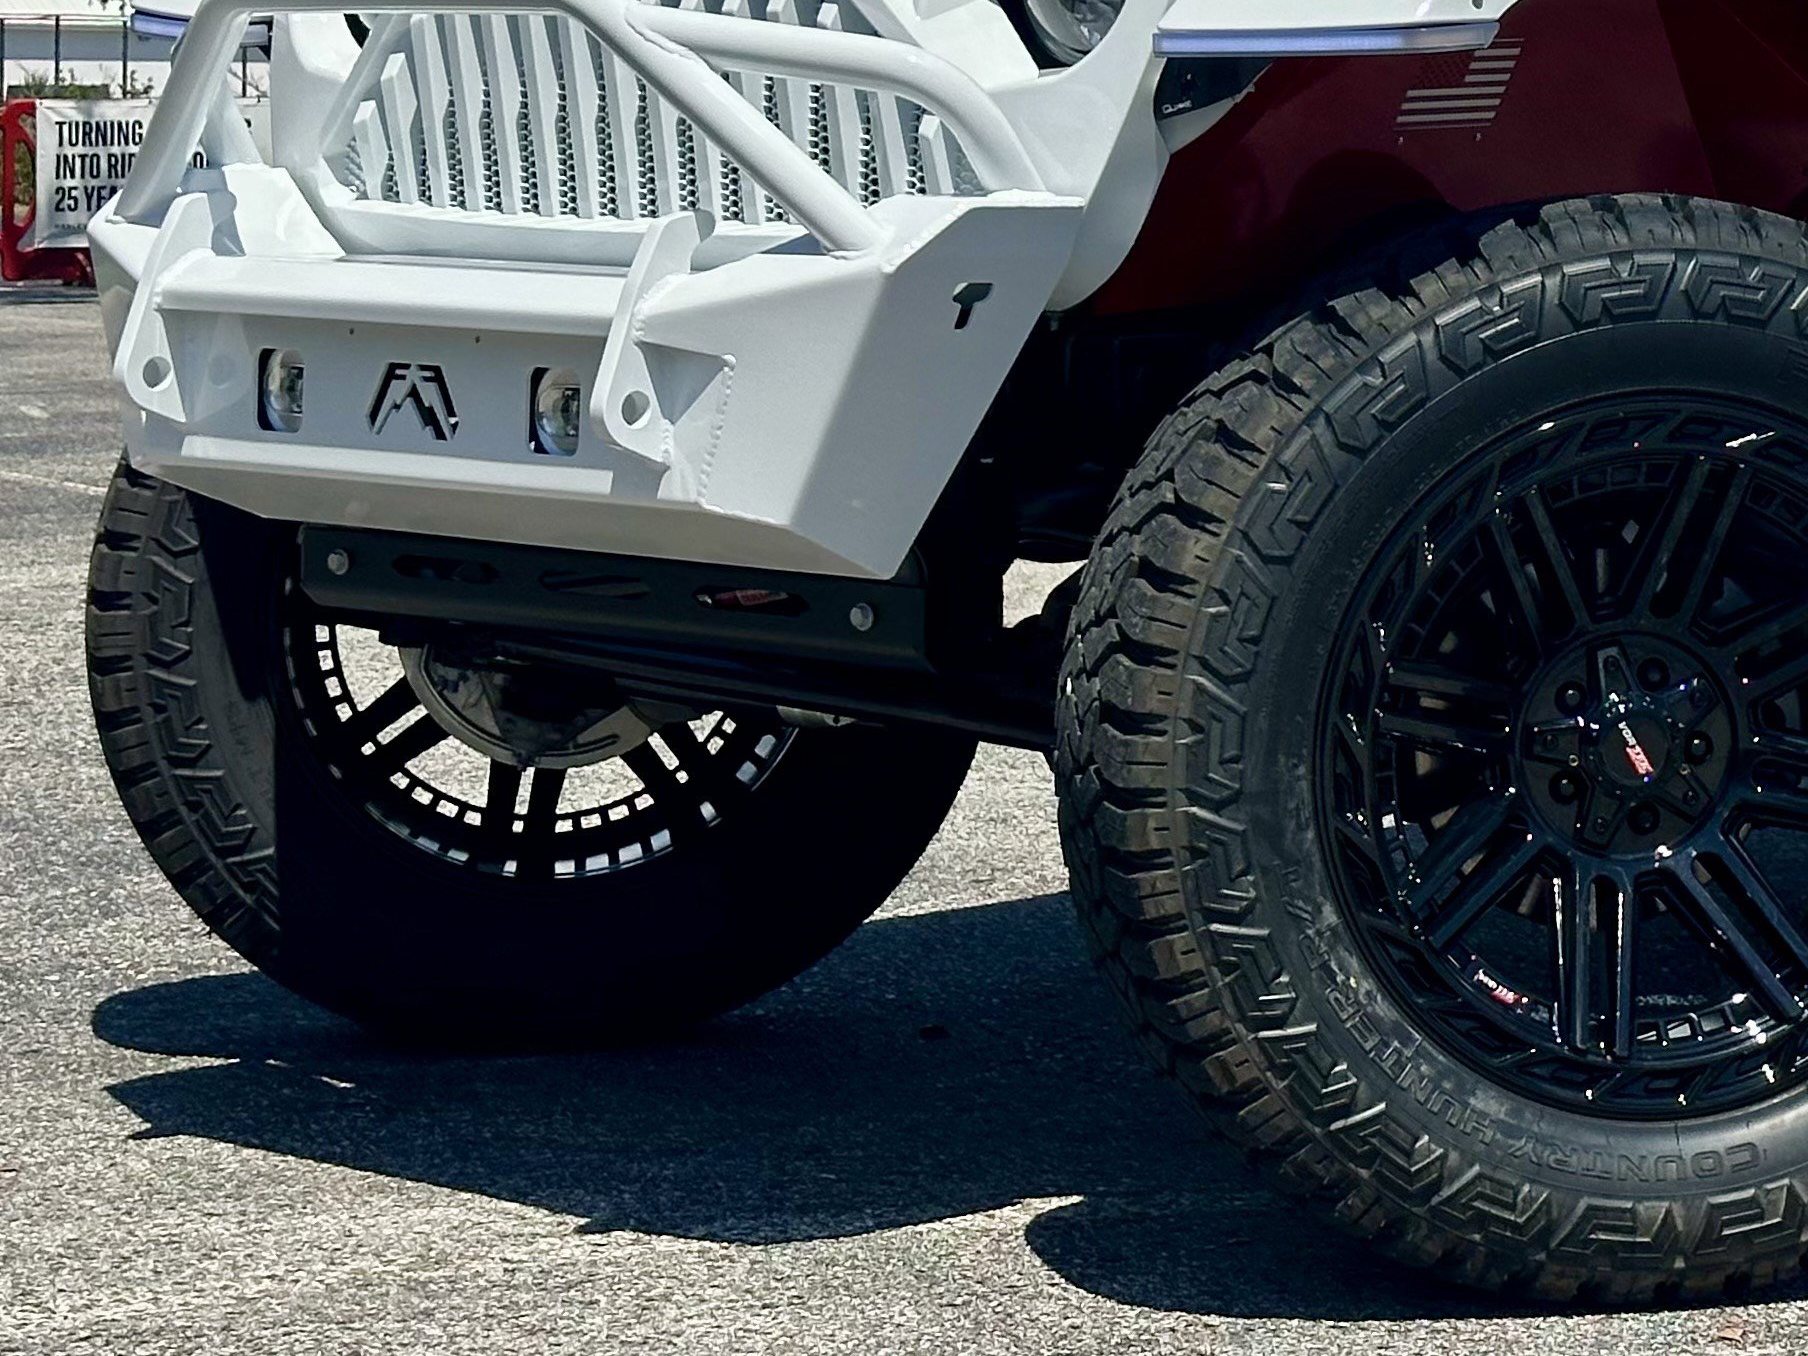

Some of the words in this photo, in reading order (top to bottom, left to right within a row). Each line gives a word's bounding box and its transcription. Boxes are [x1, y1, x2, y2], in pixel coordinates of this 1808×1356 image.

[55, 120, 144, 147] TURNING
[55, 153, 101, 180] INTO
[54, 185, 79, 212] 25
[1325, 985, 1498, 1146] HUNTER
[1510, 1135, 1763, 1184] COUNTRY
